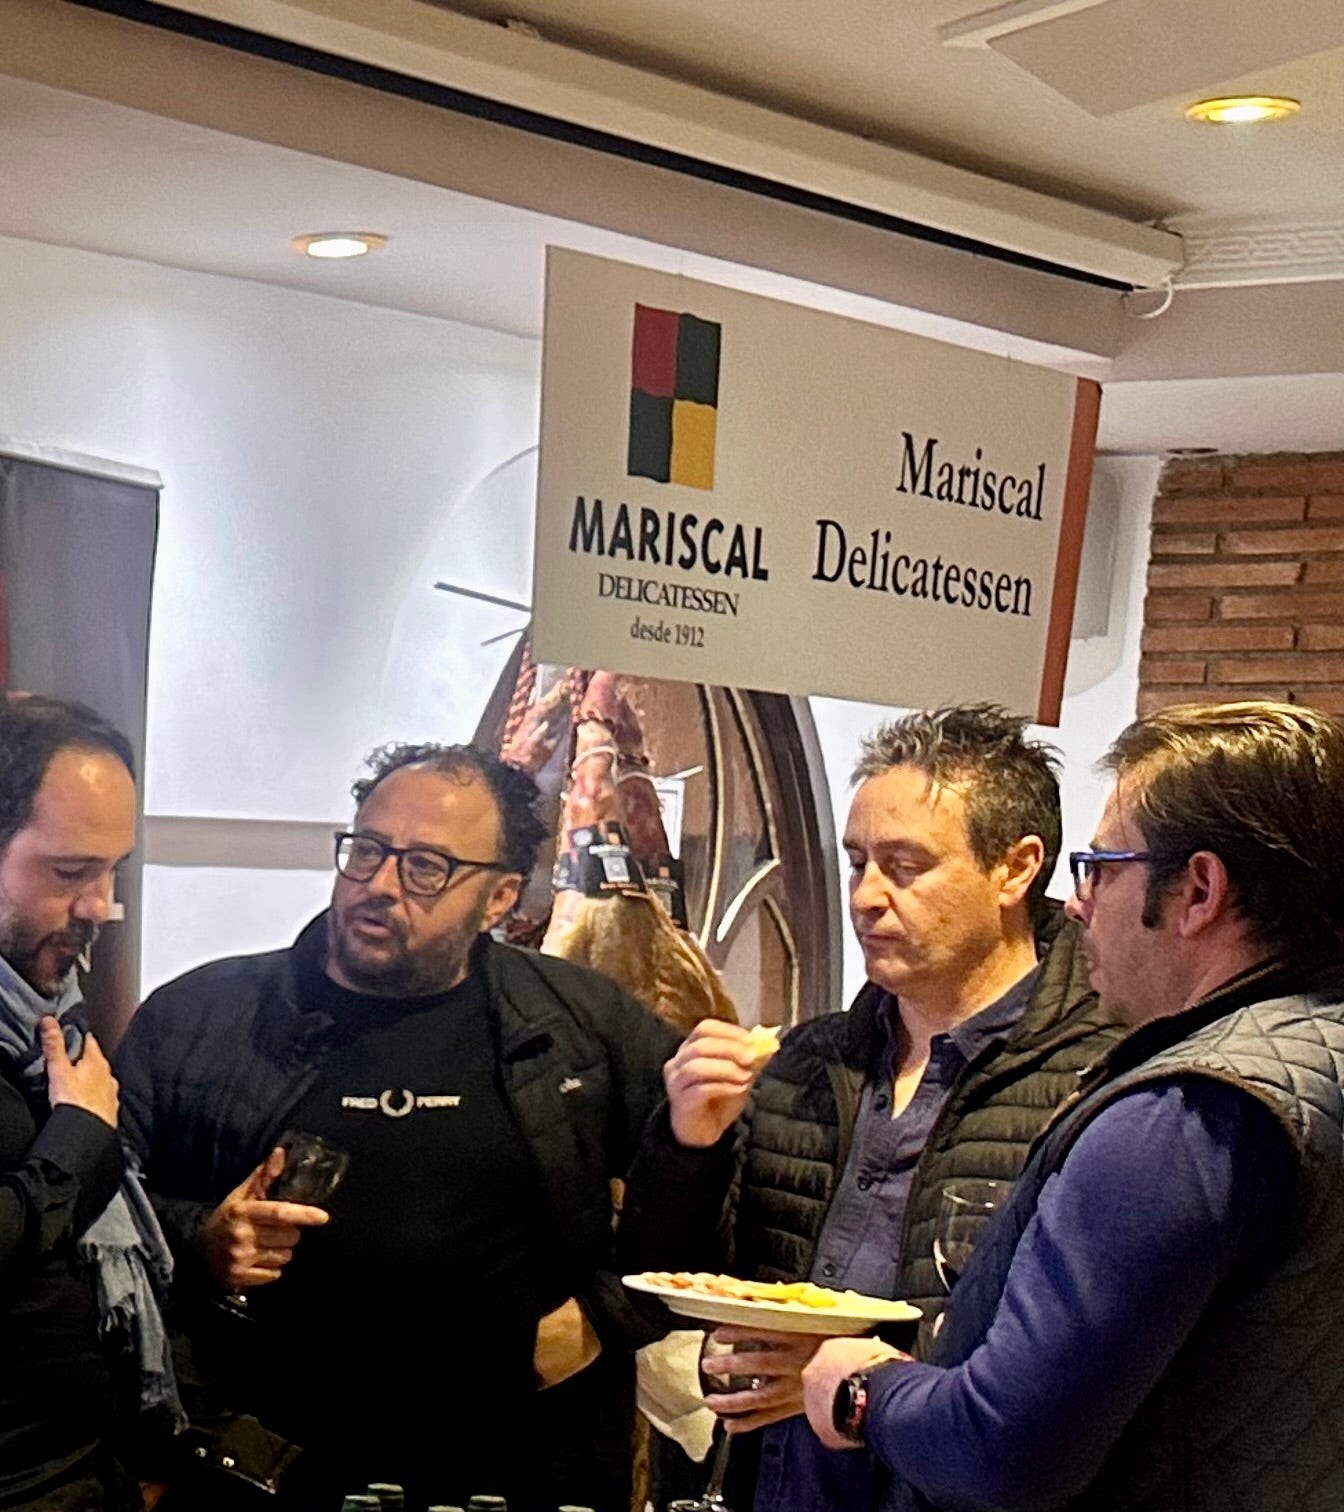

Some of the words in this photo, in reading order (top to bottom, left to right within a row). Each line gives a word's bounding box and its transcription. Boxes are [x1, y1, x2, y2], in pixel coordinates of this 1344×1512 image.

[896, 431, 1046, 522] Mariscal
[568, 496, 768, 581] MARISCAL
[812, 519, 1032, 617] Delicatessen
[598, 572, 739, 617] DELICATESSEN
[630, 617, 672, 644] desde
[674, 621, 705, 648] 1912
